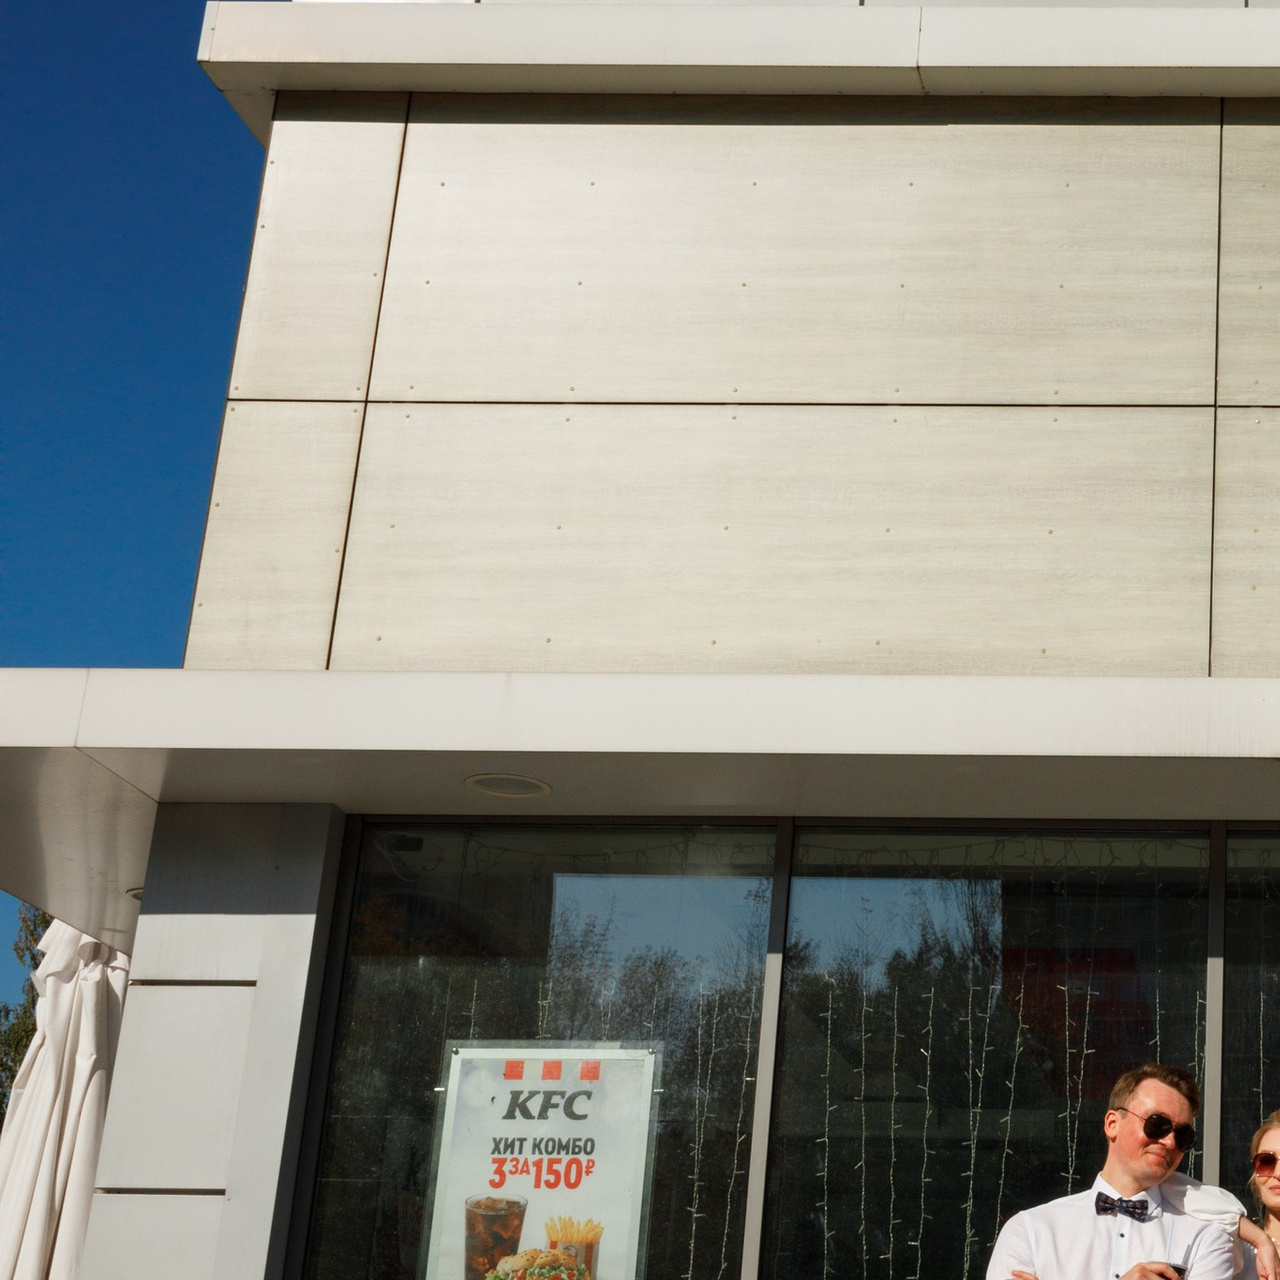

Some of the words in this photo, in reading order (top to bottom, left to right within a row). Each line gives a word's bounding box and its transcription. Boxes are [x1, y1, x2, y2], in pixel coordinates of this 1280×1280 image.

[502, 1090, 593, 1120] KFC
[490, 1137, 528, 1155] ХИТ
[532, 1137, 595, 1156] КОМБО
